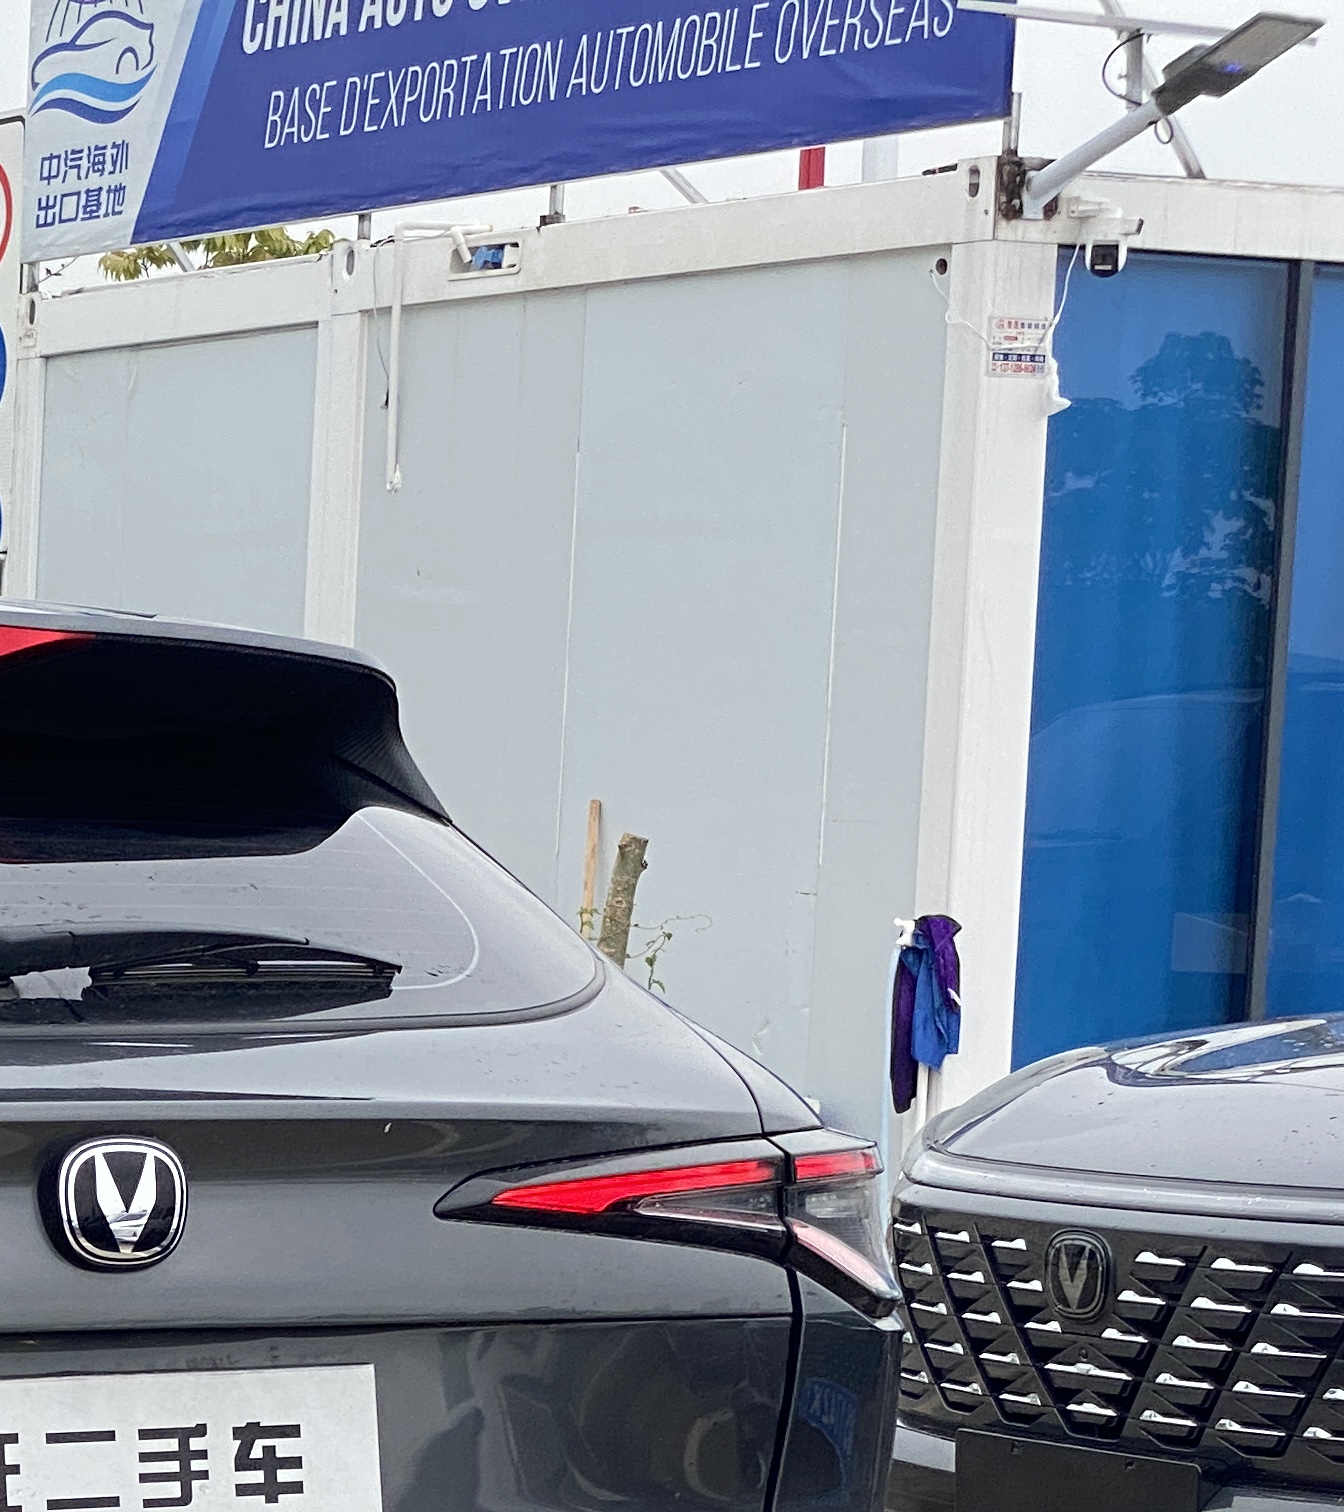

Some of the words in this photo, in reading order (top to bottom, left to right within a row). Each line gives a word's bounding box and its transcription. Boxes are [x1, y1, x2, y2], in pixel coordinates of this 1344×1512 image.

[264, 80, 337, 149] BASE
[339, 38, 564, 136] D'EXPORTATION
[565, 2, 770, 98] AUTOMOBILE
[774, 0, 955, 64] OVERSEAS
[39, 140, 129, 185] 中汽海外
[35, 183, 127, 229] 出口基地
